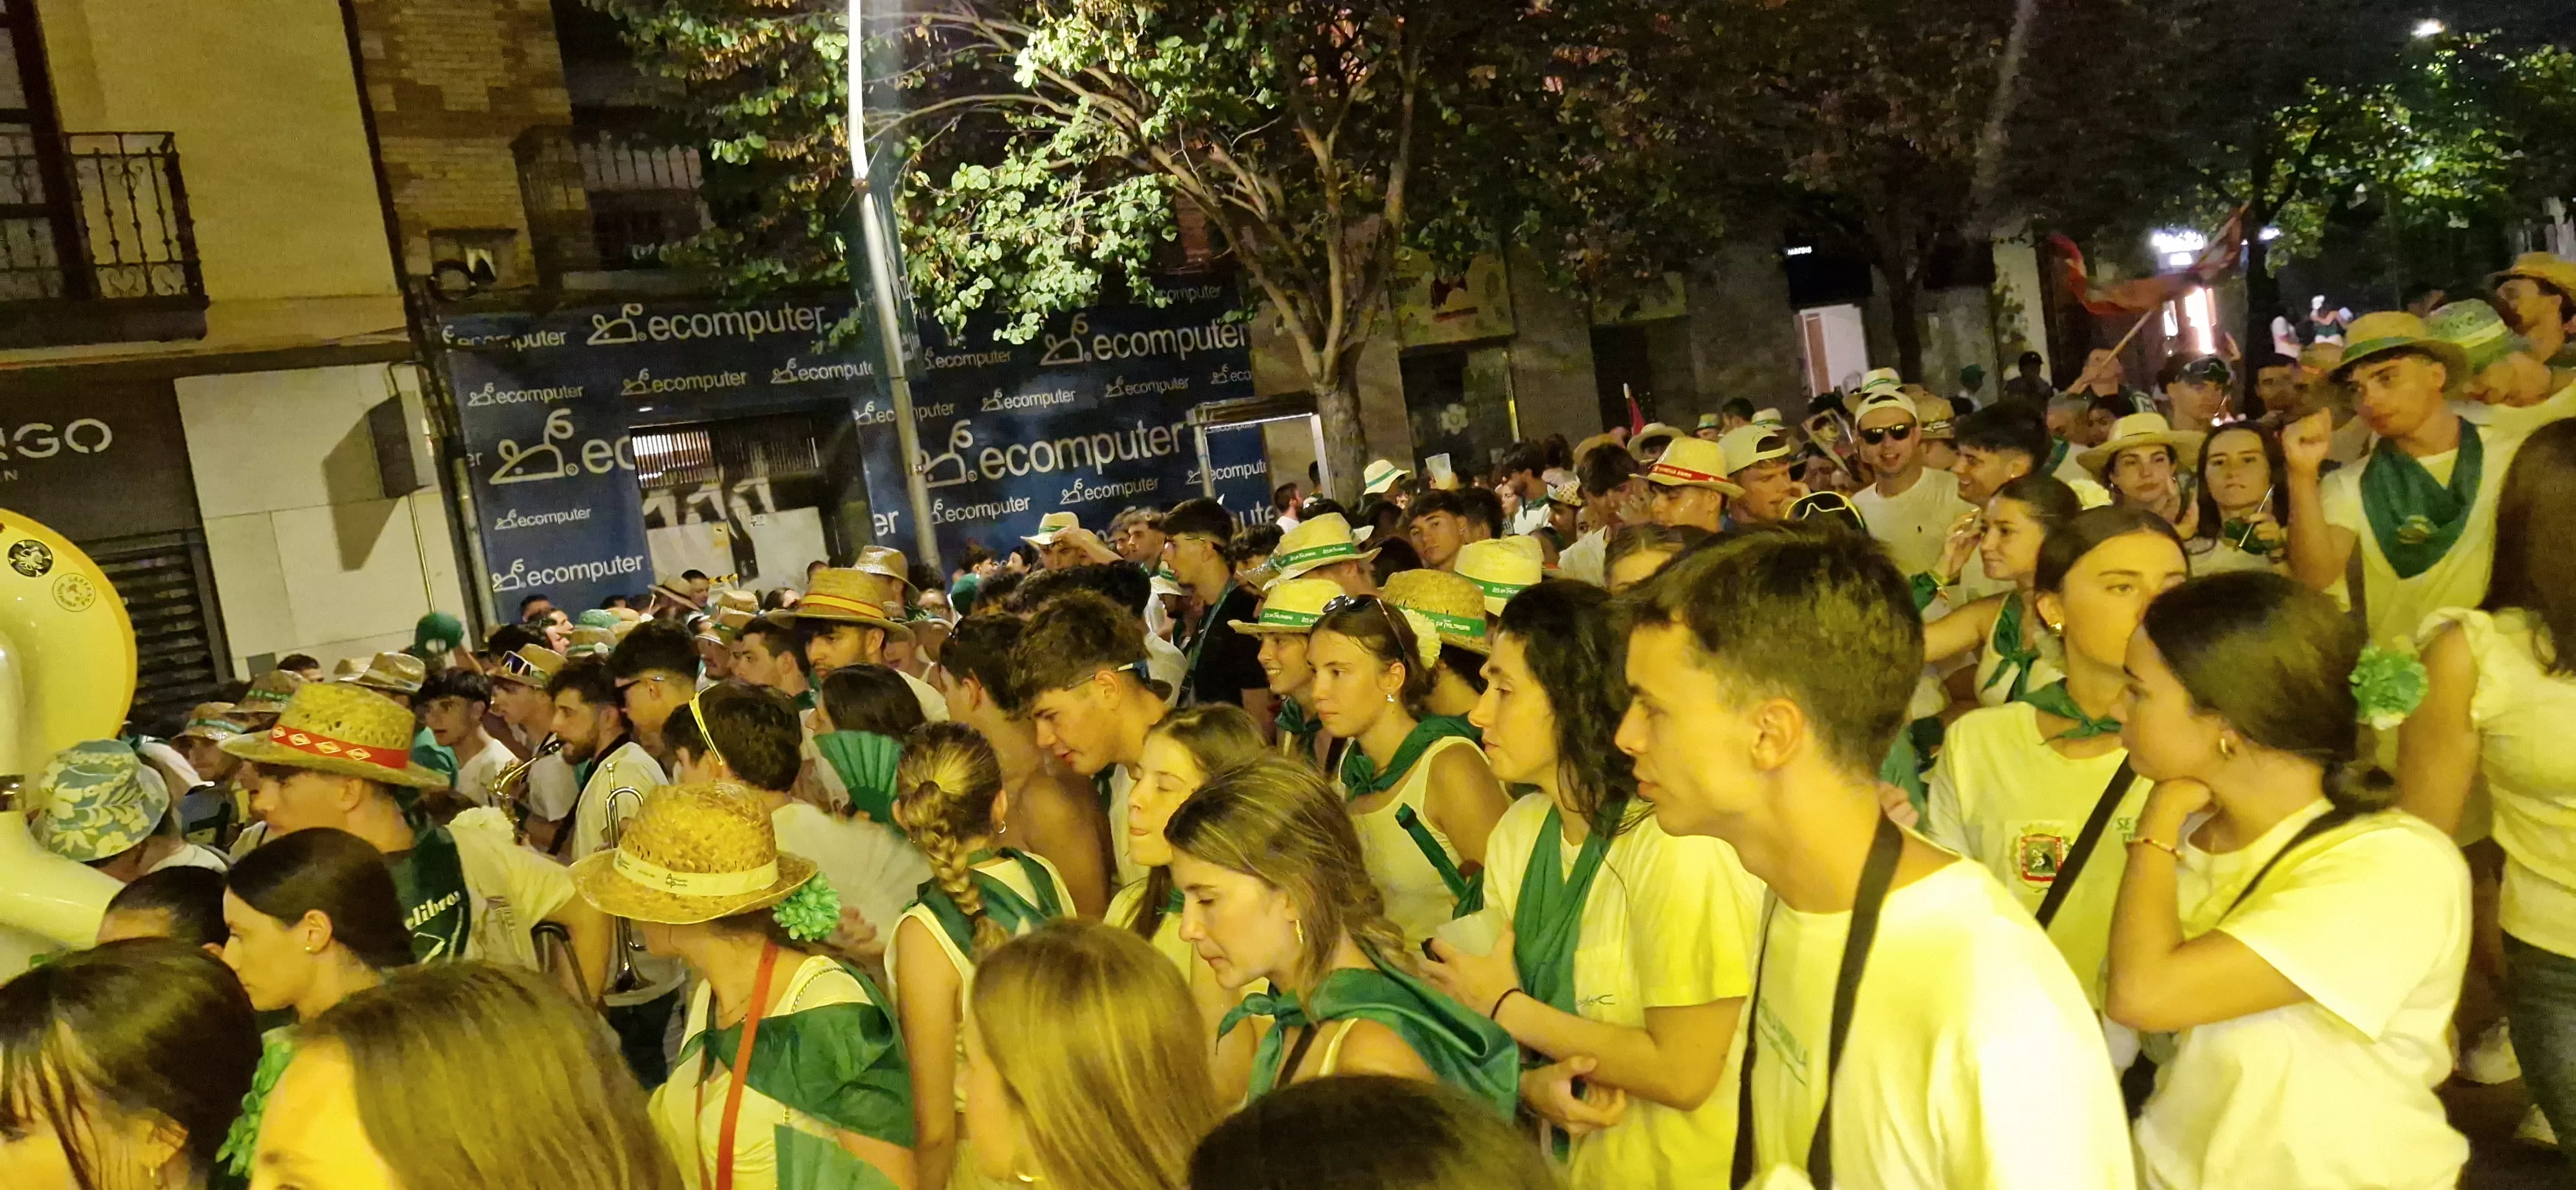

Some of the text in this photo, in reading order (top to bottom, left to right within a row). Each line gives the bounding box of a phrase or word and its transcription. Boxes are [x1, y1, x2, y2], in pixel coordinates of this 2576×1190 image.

[648, 302, 826, 341] ecomputer
[1093, 317, 1249, 361] ecomputer
[936, 350, 1012, 368] ecomputer
[798, 360, 874, 381] ecomput
[651, 371, 748, 392] ecomputer
[1125, 377, 1189, 395] ecomputer
[496, 386, 583, 403] ecomputer
[1004, 388, 1076, 409] ecomputer
[980, 419, 1184, 480] ecomputer
[1211, 459, 1267, 479] ecomput
[1084, 477, 1158, 500] ecomputer
[518, 508, 591, 527] ecomputer
[945, 495, 1030, 523] ecomputer
[527, 555, 643, 587] ecomputer
